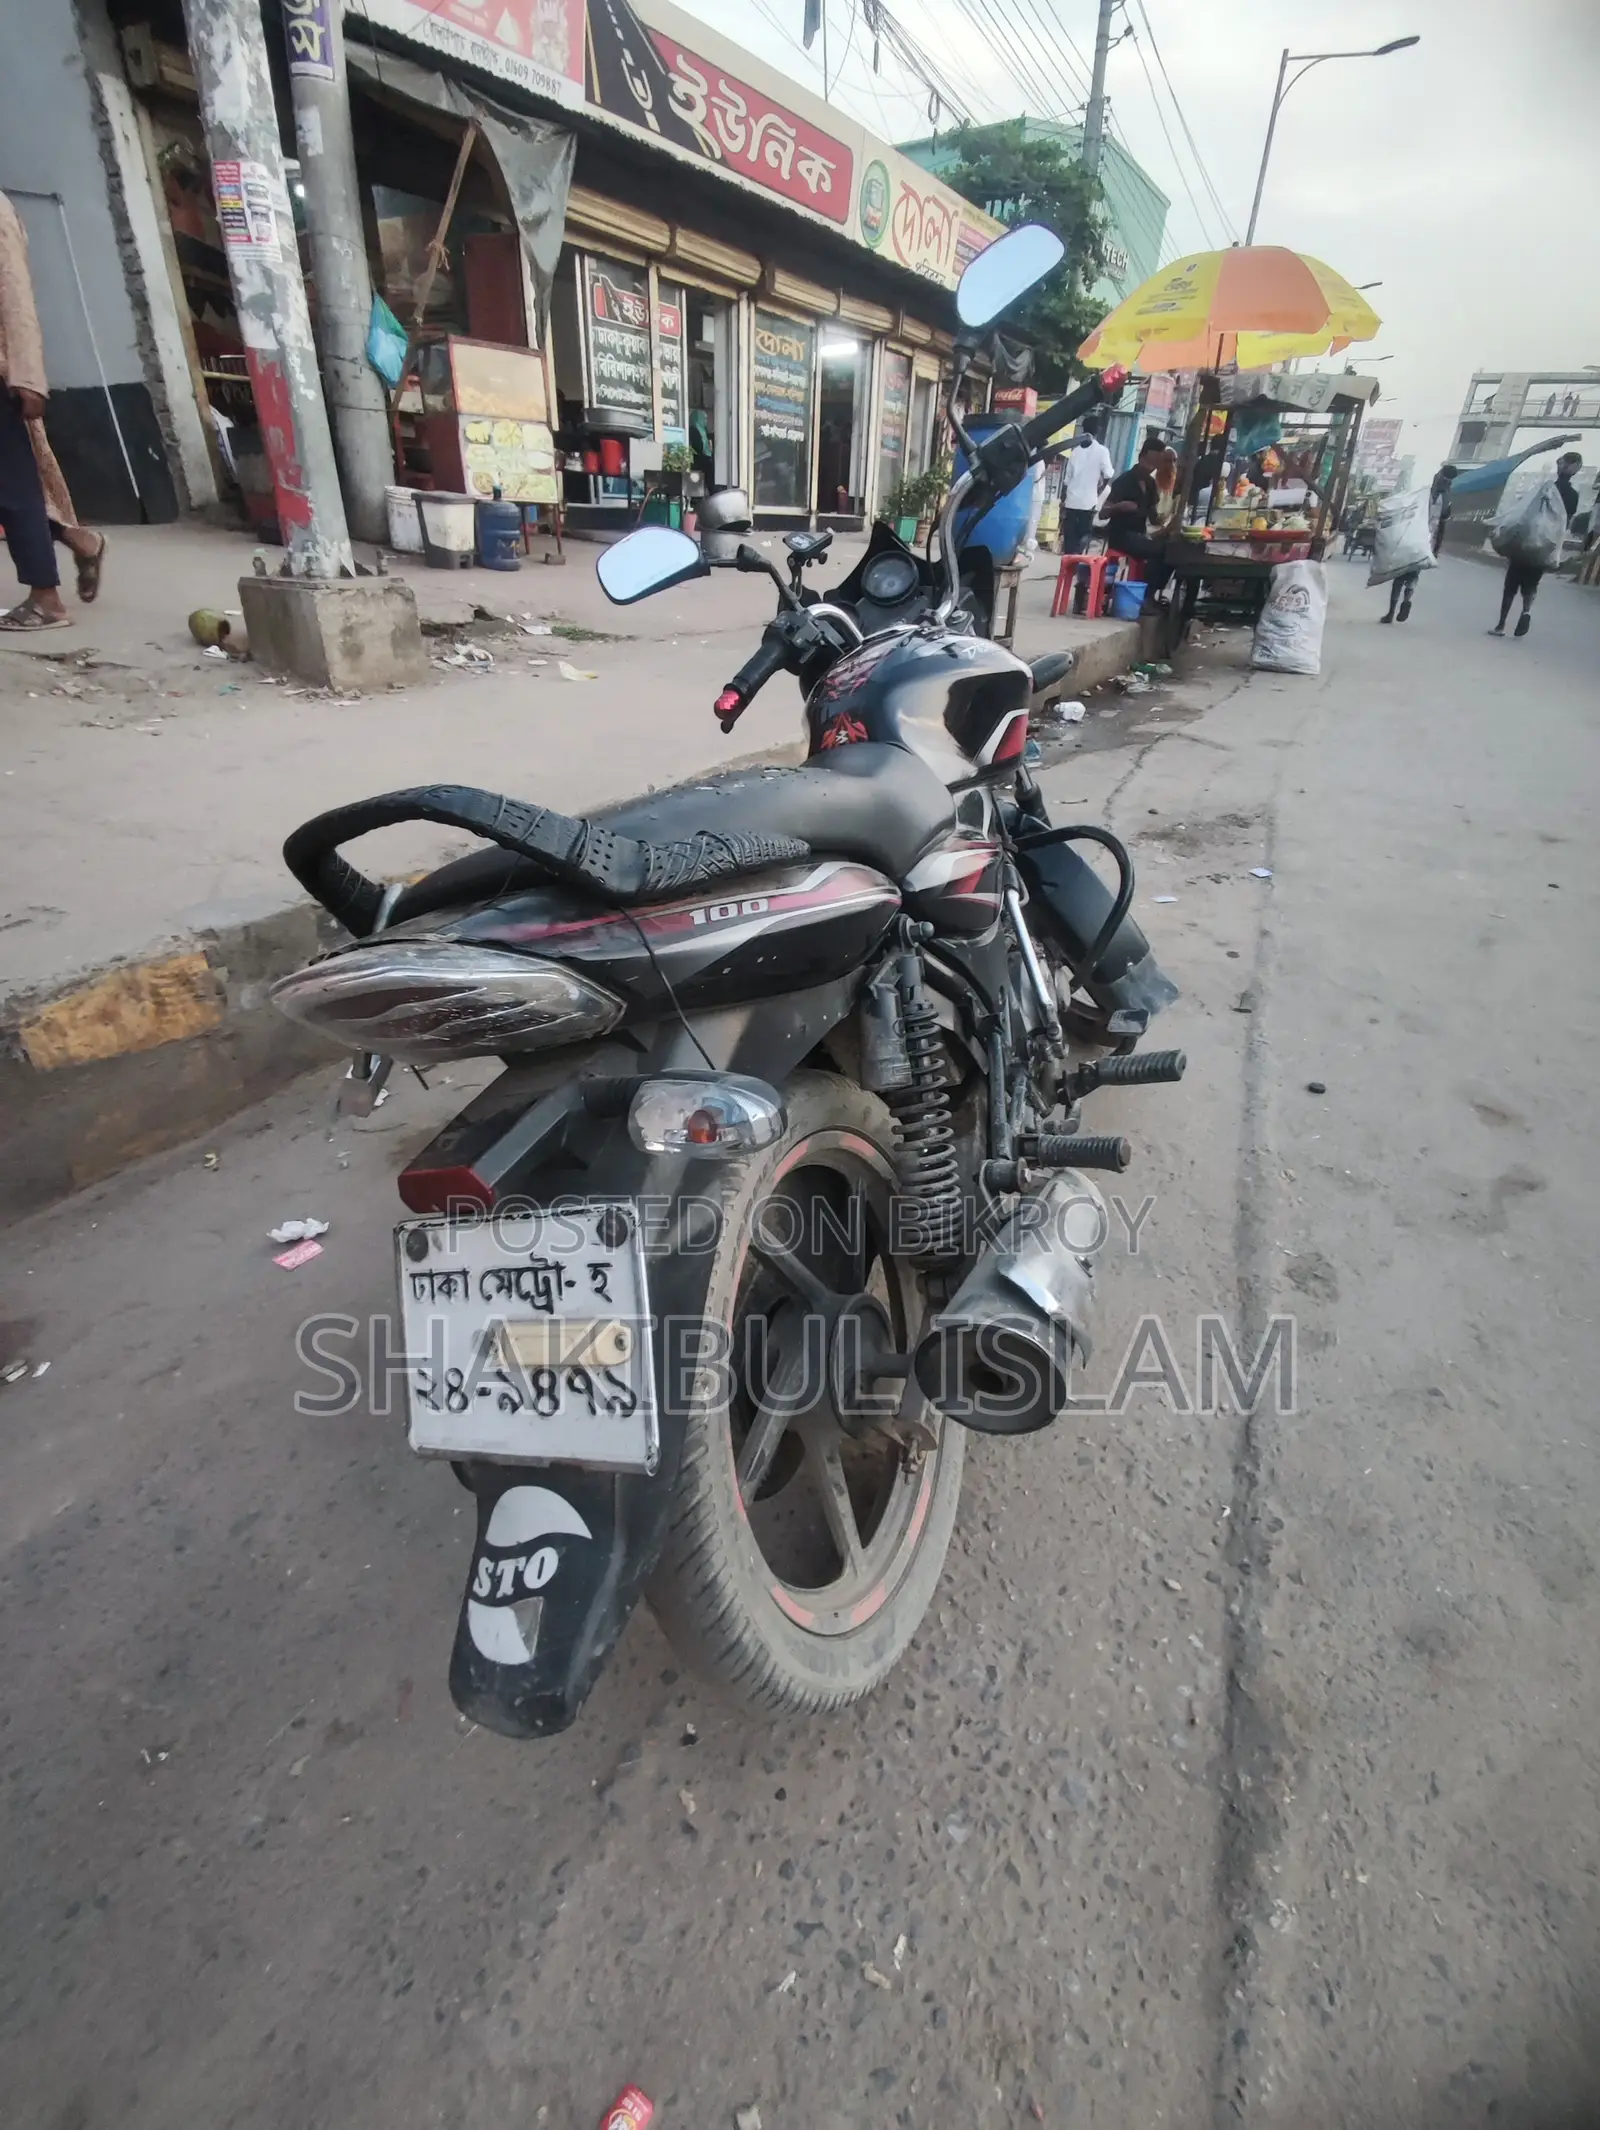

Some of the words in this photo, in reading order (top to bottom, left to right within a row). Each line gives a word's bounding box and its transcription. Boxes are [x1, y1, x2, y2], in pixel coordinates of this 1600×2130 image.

[667, 54, 837, 193] ইউনিক
[891, 180, 959, 268] দোলা
[689, 898, 769, 925] 100
[409, 1267, 470, 1304] ঢাকা
